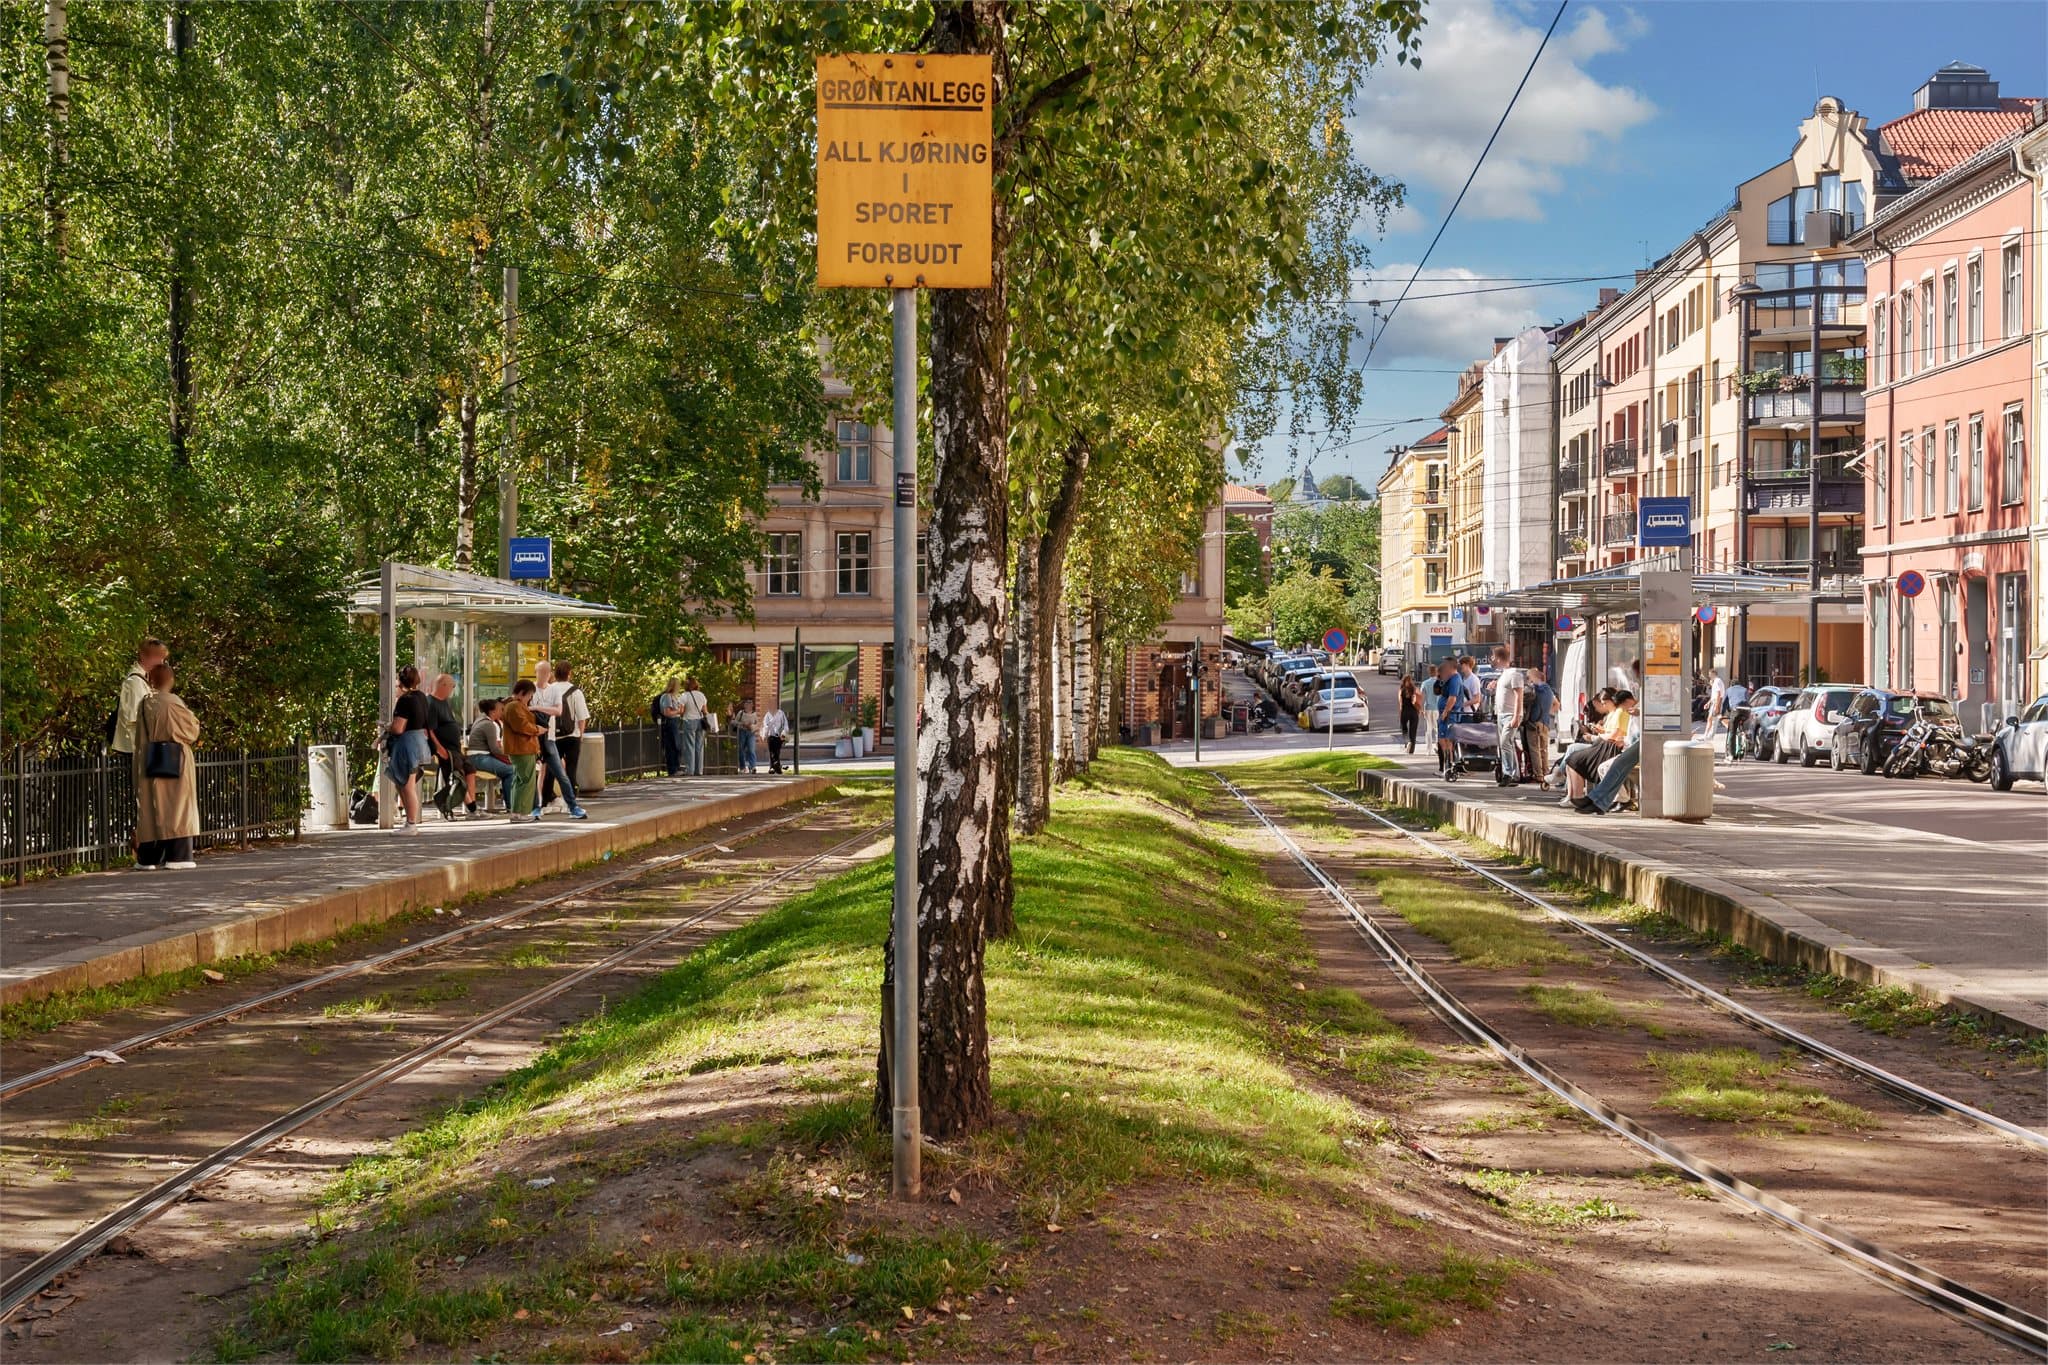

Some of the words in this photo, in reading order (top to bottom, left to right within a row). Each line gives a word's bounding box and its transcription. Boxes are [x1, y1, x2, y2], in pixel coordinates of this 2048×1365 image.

[822, 79, 986, 104] GRØNTANLEGG
[824, 141, 872, 163] ALL
[879, 142, 987, 164] KJØRING
[903, 173, 908, 193] I
[855, 202, 953, 224] SPORET
[847, 242, 963, 264] FORBUDT
